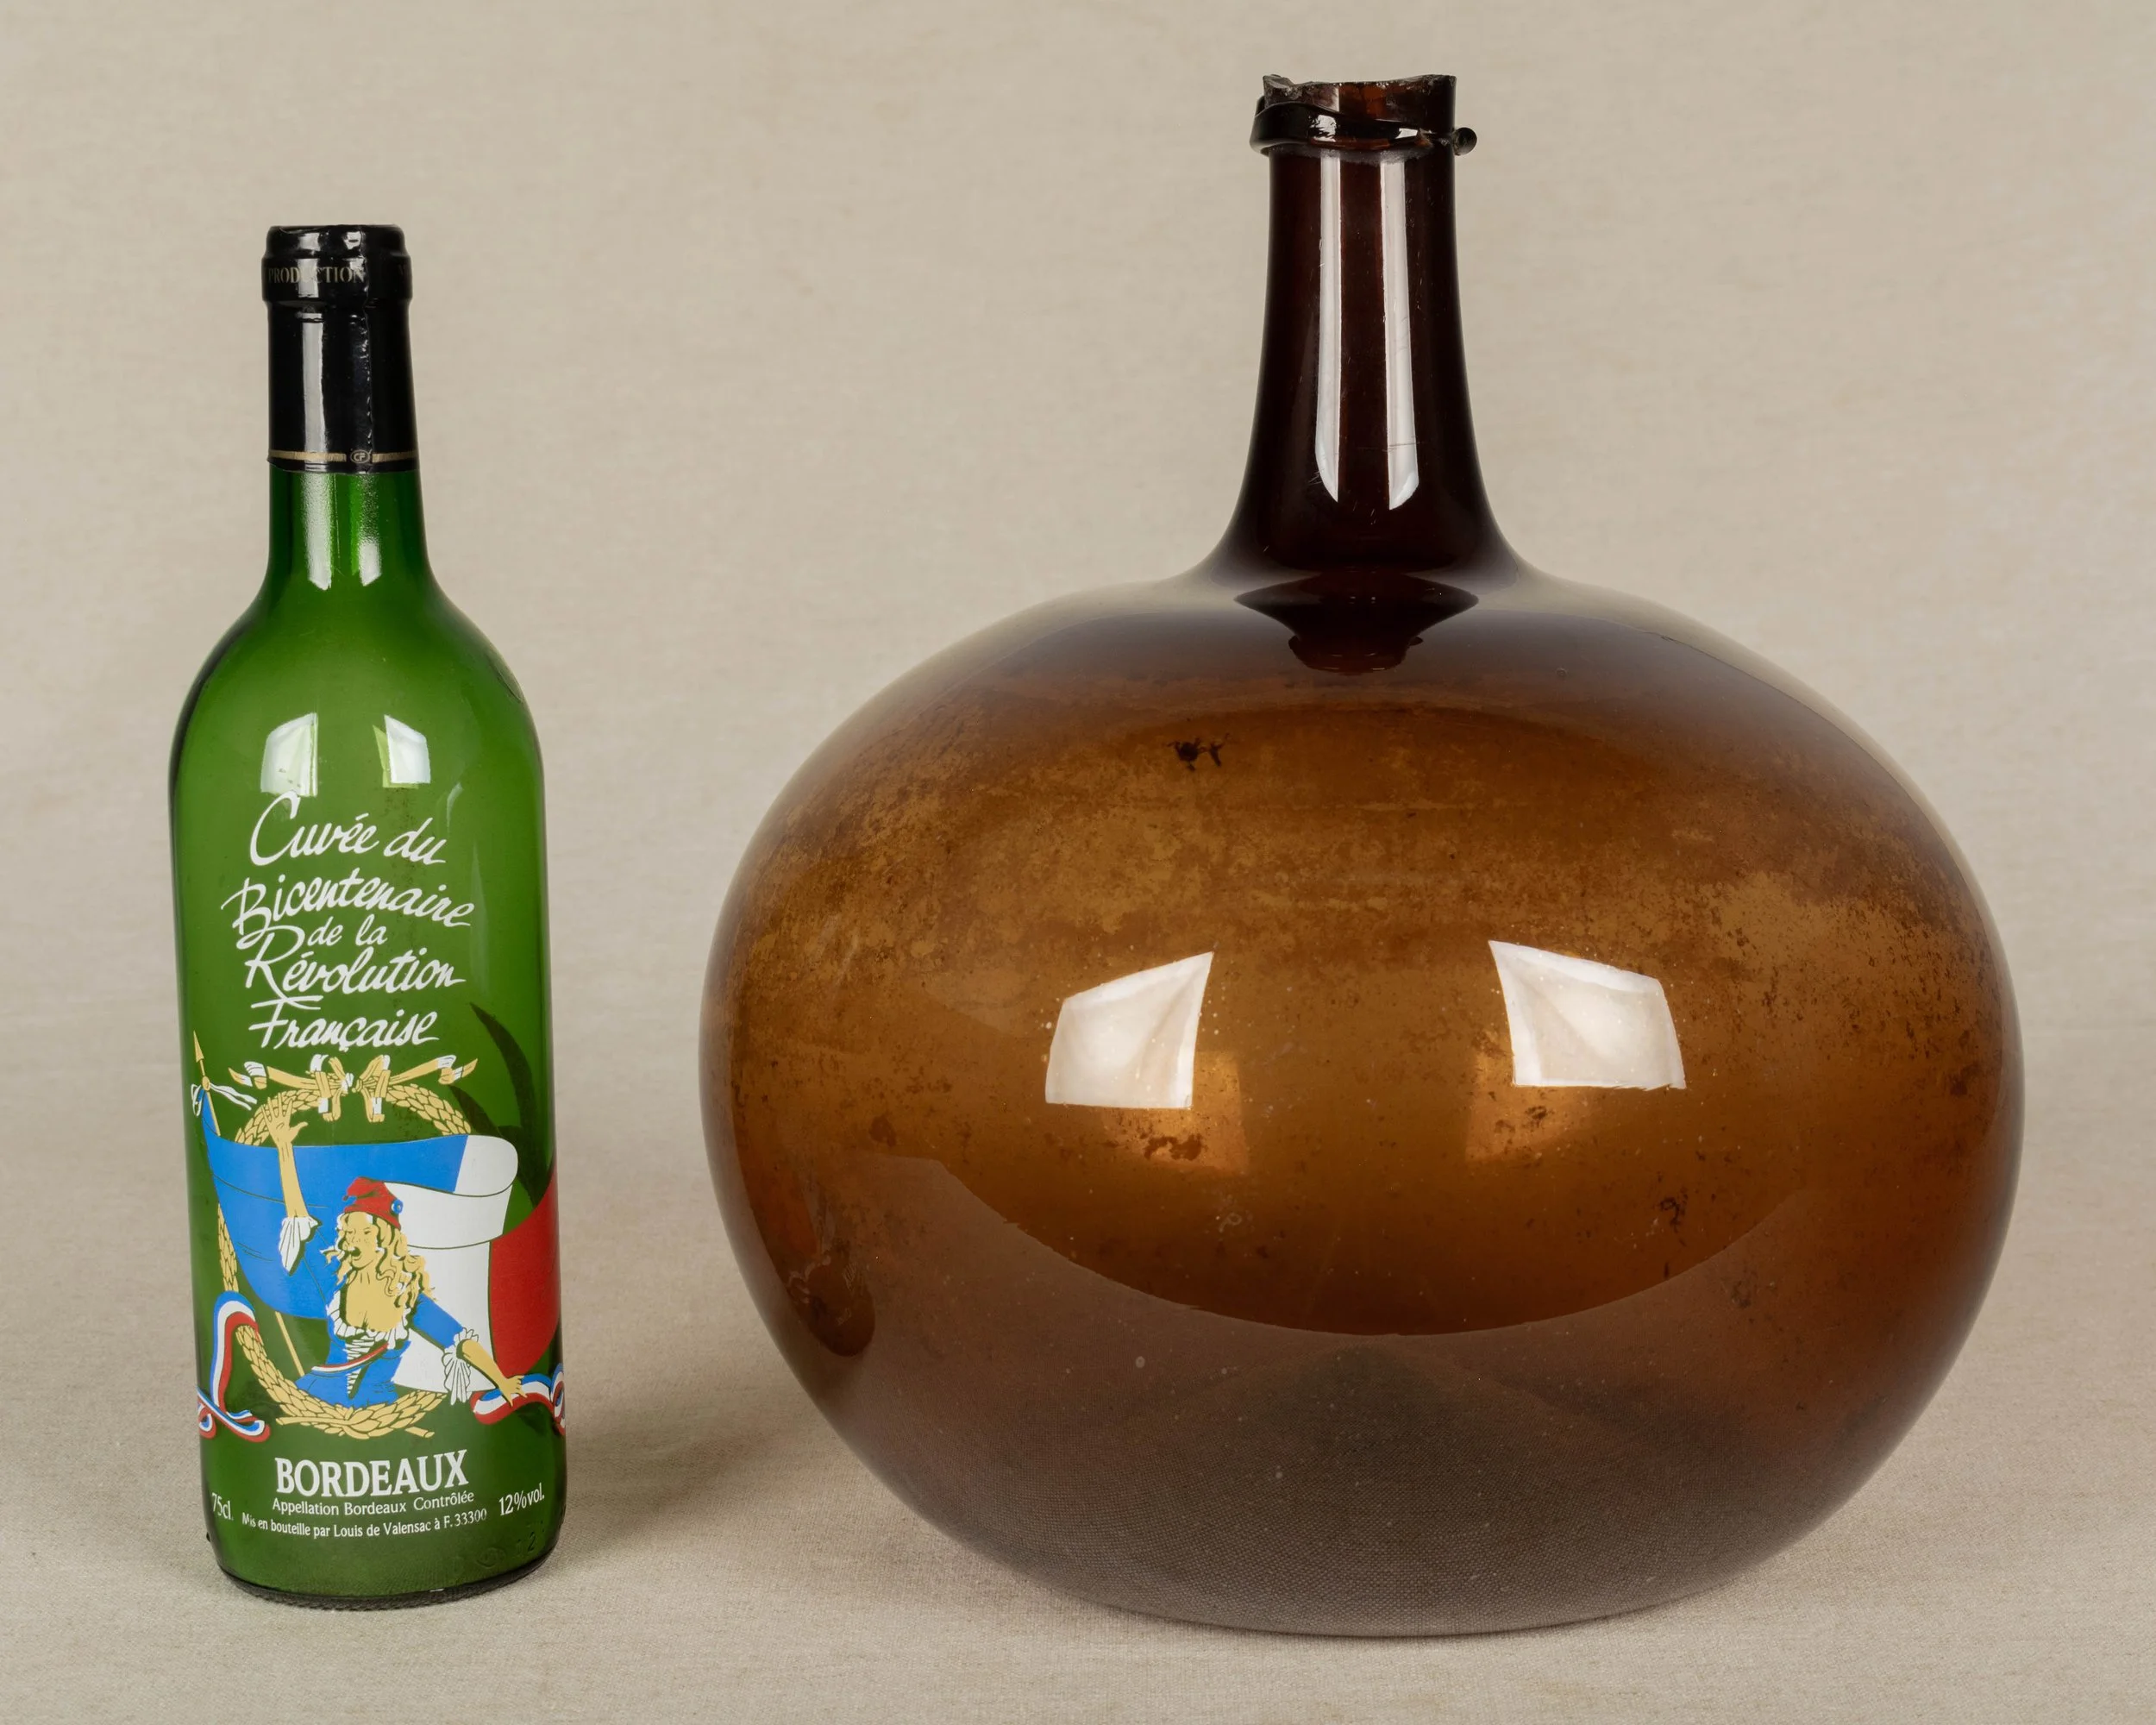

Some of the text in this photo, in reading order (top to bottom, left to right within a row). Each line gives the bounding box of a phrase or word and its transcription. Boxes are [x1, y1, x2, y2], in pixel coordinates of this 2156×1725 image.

[268, 266, 365, 284] PRODCTION
[354, 453, 366, 461] CF
[249, 790, 448, 867] Cuvée du
[221, 867, 475, 950] Bicentenaire
[307, 913, 388, 947] de la
[244, 924, 467, 1011] Révolution
[249, 995, 440, 1052] Française
[274, 1449, 469, 1498] BORDEAUX
[272, 1490, 475, 1516] Appellation Bordeaux Contrôlée
[241, 1511, 257, 1528] Mis
[258, 1519, 269, 1531] en
[270, 1518, 311, 1536] bouteille
[312, 1526, 330, 1540] par
[333, 1524, 364, 1538] Louis
[366, 1523, 380, 1537] de
[382, 1520, 432, 1536] Valensac
[434, 1517, 441, 1530] à
